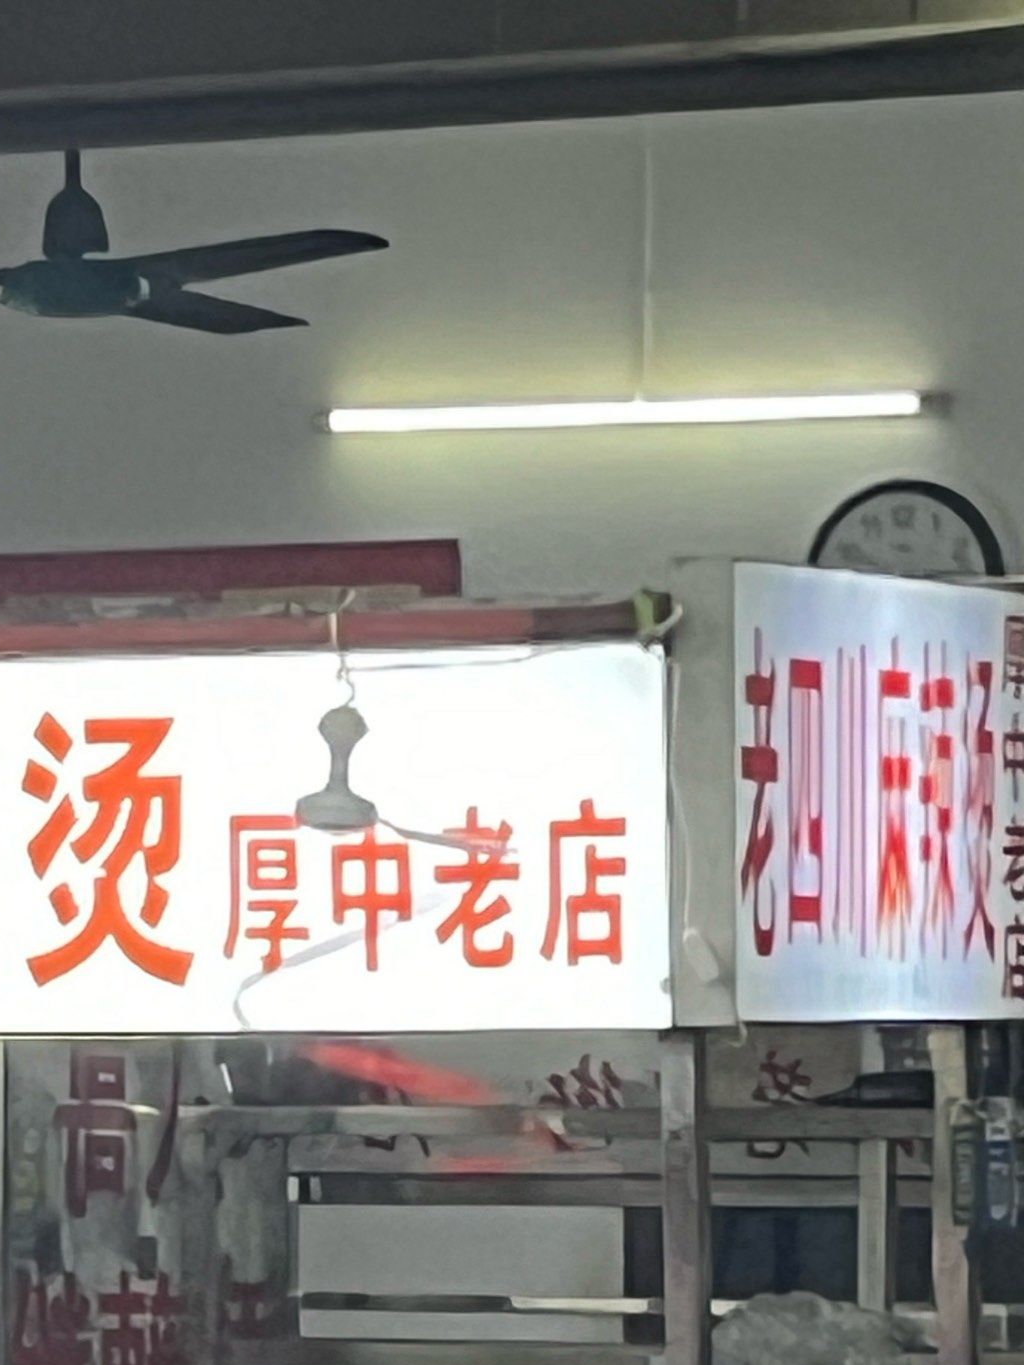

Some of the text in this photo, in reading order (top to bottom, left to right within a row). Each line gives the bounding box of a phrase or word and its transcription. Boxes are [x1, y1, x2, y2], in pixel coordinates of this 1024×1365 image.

[223, 798, 627, 975] 厚中老店
[741, 626, 996, 963] 老四川麻辣烫
